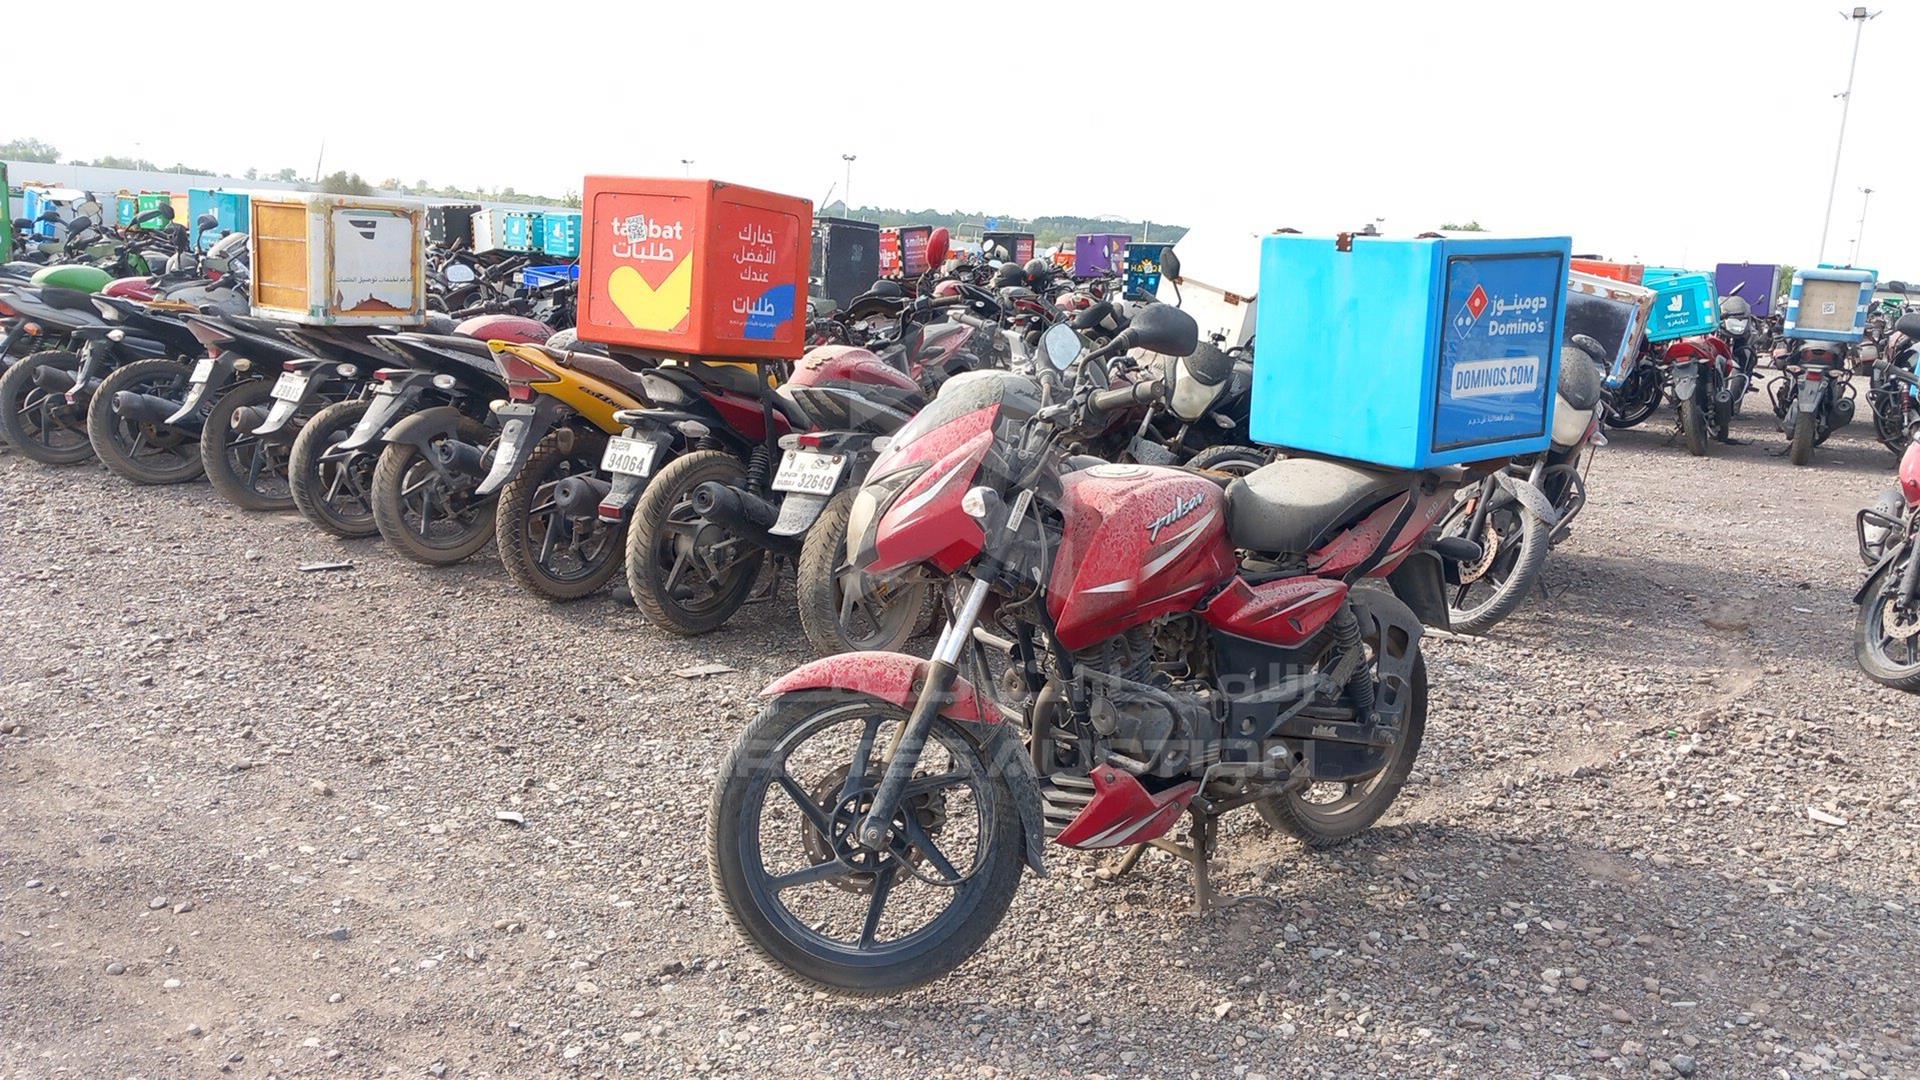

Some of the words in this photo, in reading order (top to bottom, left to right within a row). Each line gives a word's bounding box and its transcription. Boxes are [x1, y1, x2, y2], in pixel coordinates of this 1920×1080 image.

[611, 216, 683, 240] tabat
[738, 223, 773, 246] خيارك
[612, 241, 674, 263] طلبات
[740, 266, 769, 283] عندك
[732, 296, 775, 319] طلبات
[1488, 316, 1545, 336] Domino's
[1456, 365, 1534, 391] DOMINOS.COM
[608, 452, 646, 474] 94064
[797, 473, 835, 491] 32649
